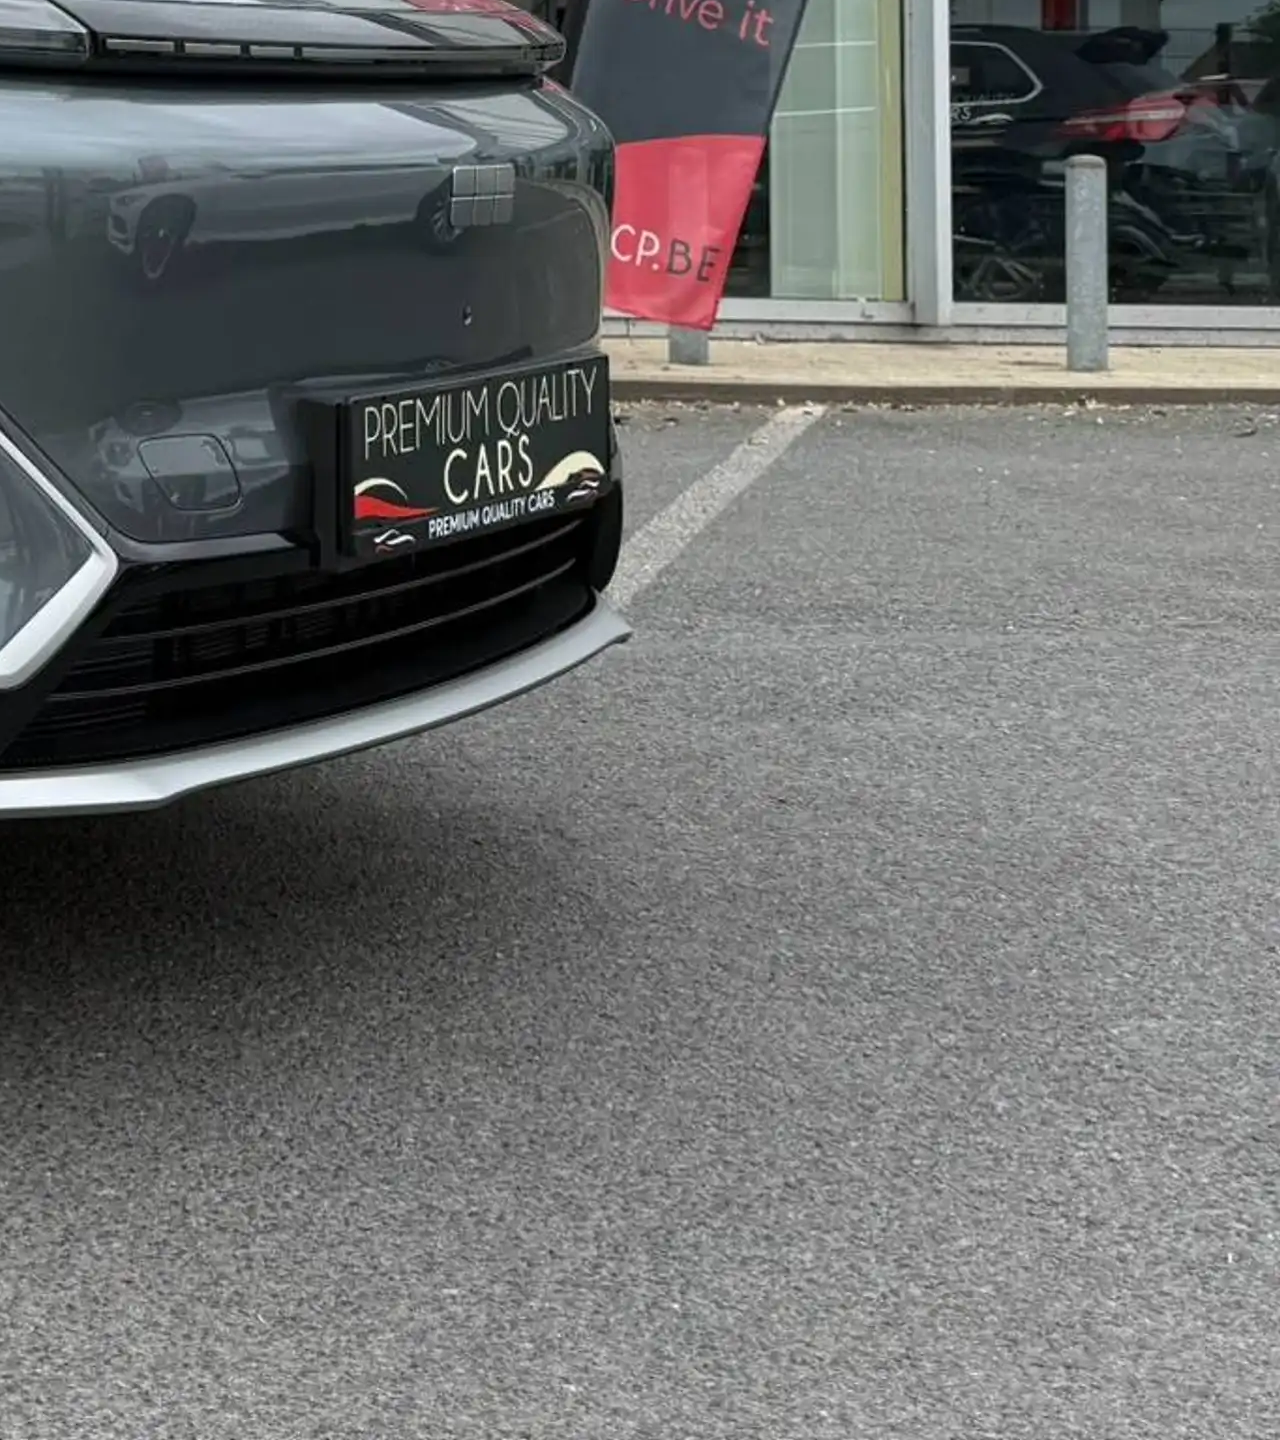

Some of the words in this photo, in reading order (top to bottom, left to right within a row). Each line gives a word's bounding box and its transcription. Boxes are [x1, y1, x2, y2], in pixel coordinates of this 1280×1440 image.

[739, 0, 774, 47] it
[364, 386, 490, 460] PREMIUM
[496, 366, 598, 438] QUALITY
[443, 434, 535, 505] CARS
[428, 506, 480, 540] PREMIUM
[482, 495, 527, 525] QUALITY
[528, 489, 556, 512] CARS
